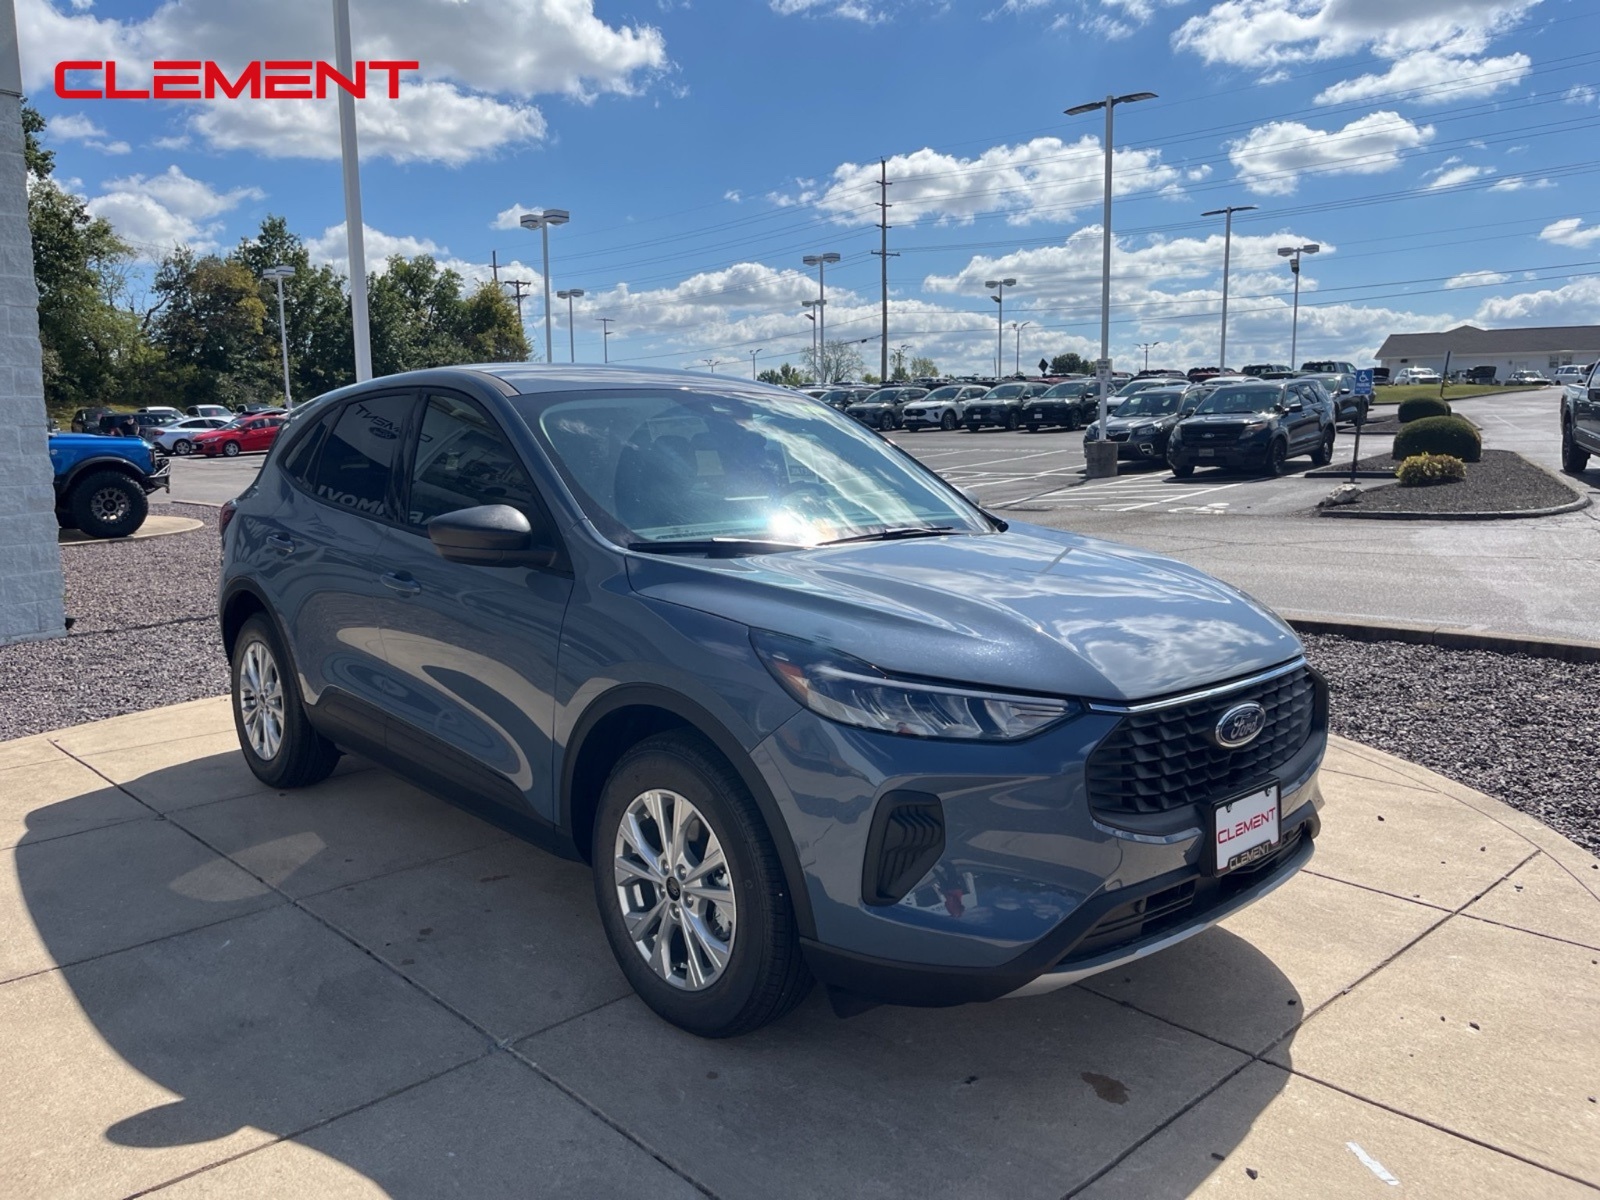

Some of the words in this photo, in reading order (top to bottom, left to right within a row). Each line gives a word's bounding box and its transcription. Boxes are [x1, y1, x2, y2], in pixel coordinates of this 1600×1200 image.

[1229, 711, 1259, 740] Ford
[1217, 807, 1276, 844] CLEMENT
[1228, 842, 1271, 870] CLEMENT
